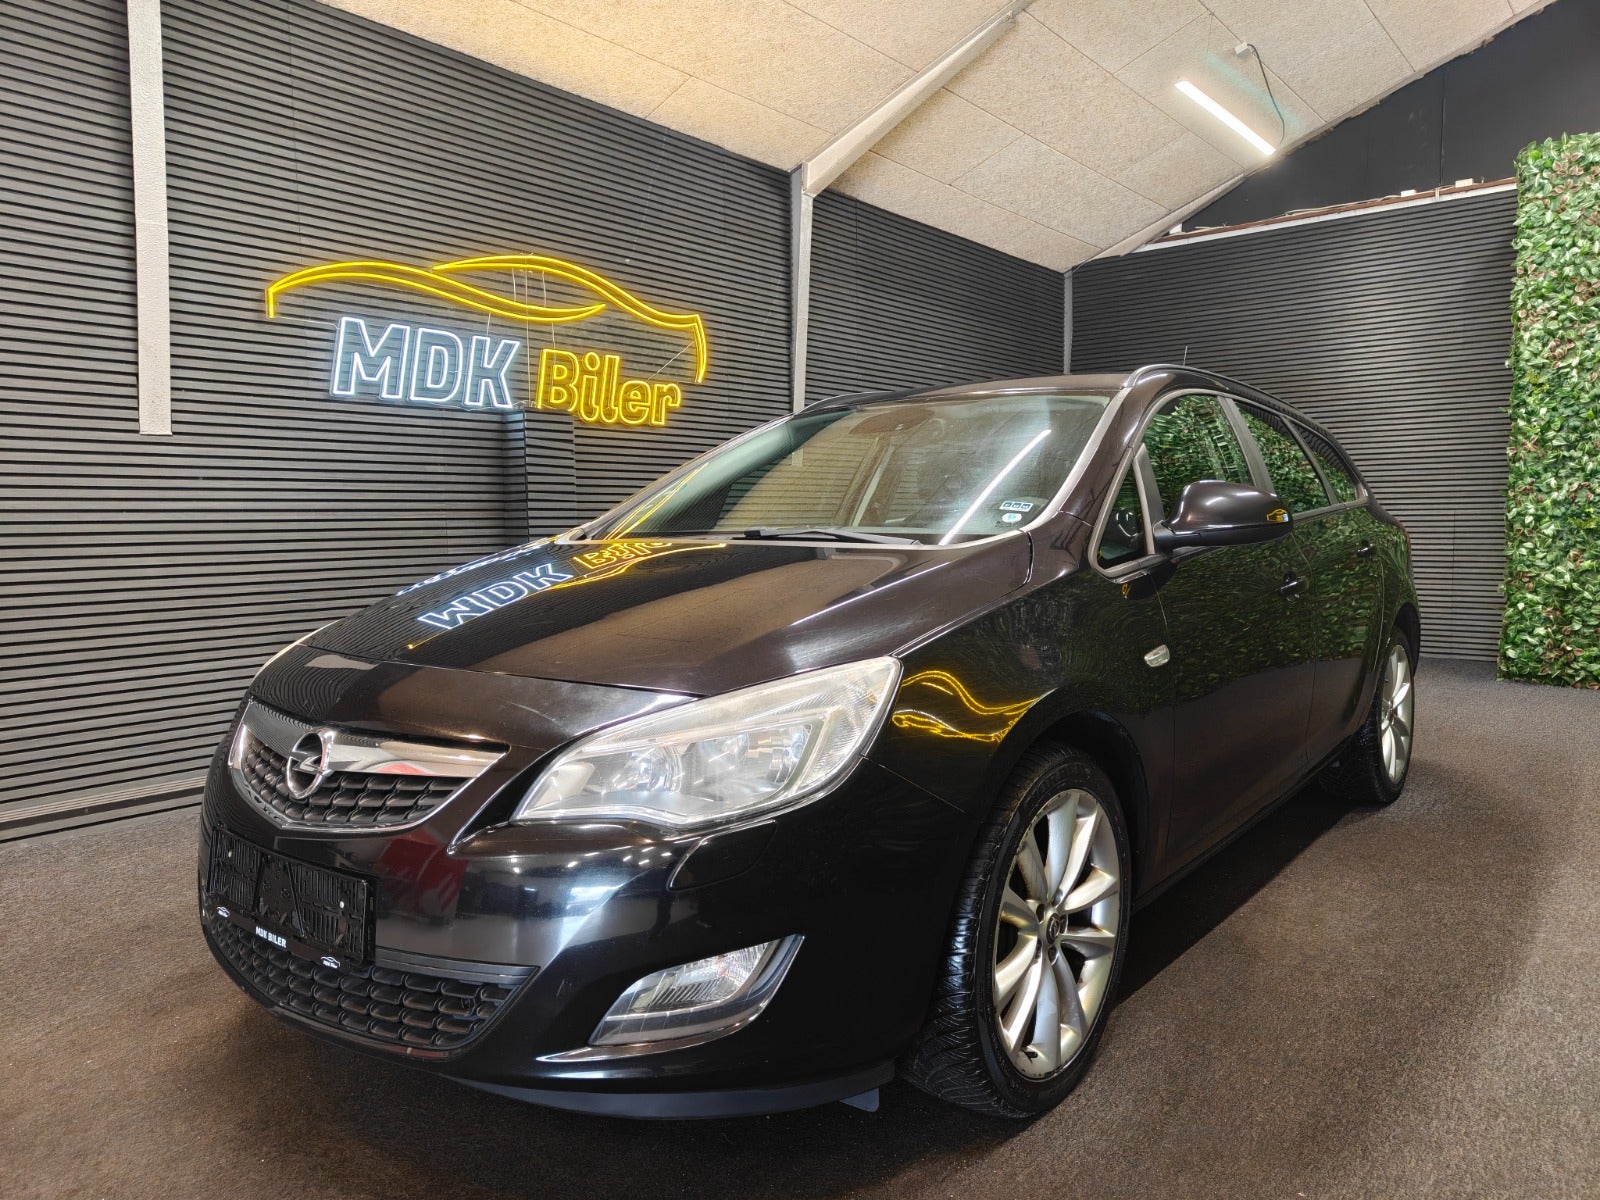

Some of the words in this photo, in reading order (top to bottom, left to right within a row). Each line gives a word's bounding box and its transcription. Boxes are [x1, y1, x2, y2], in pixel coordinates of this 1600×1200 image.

[332, 317, 521, 409] MDK
[537, 347, 682, 427] Biler
[255, 926, 267, 939] MDK
[268, 932, 287, 948] BILER
